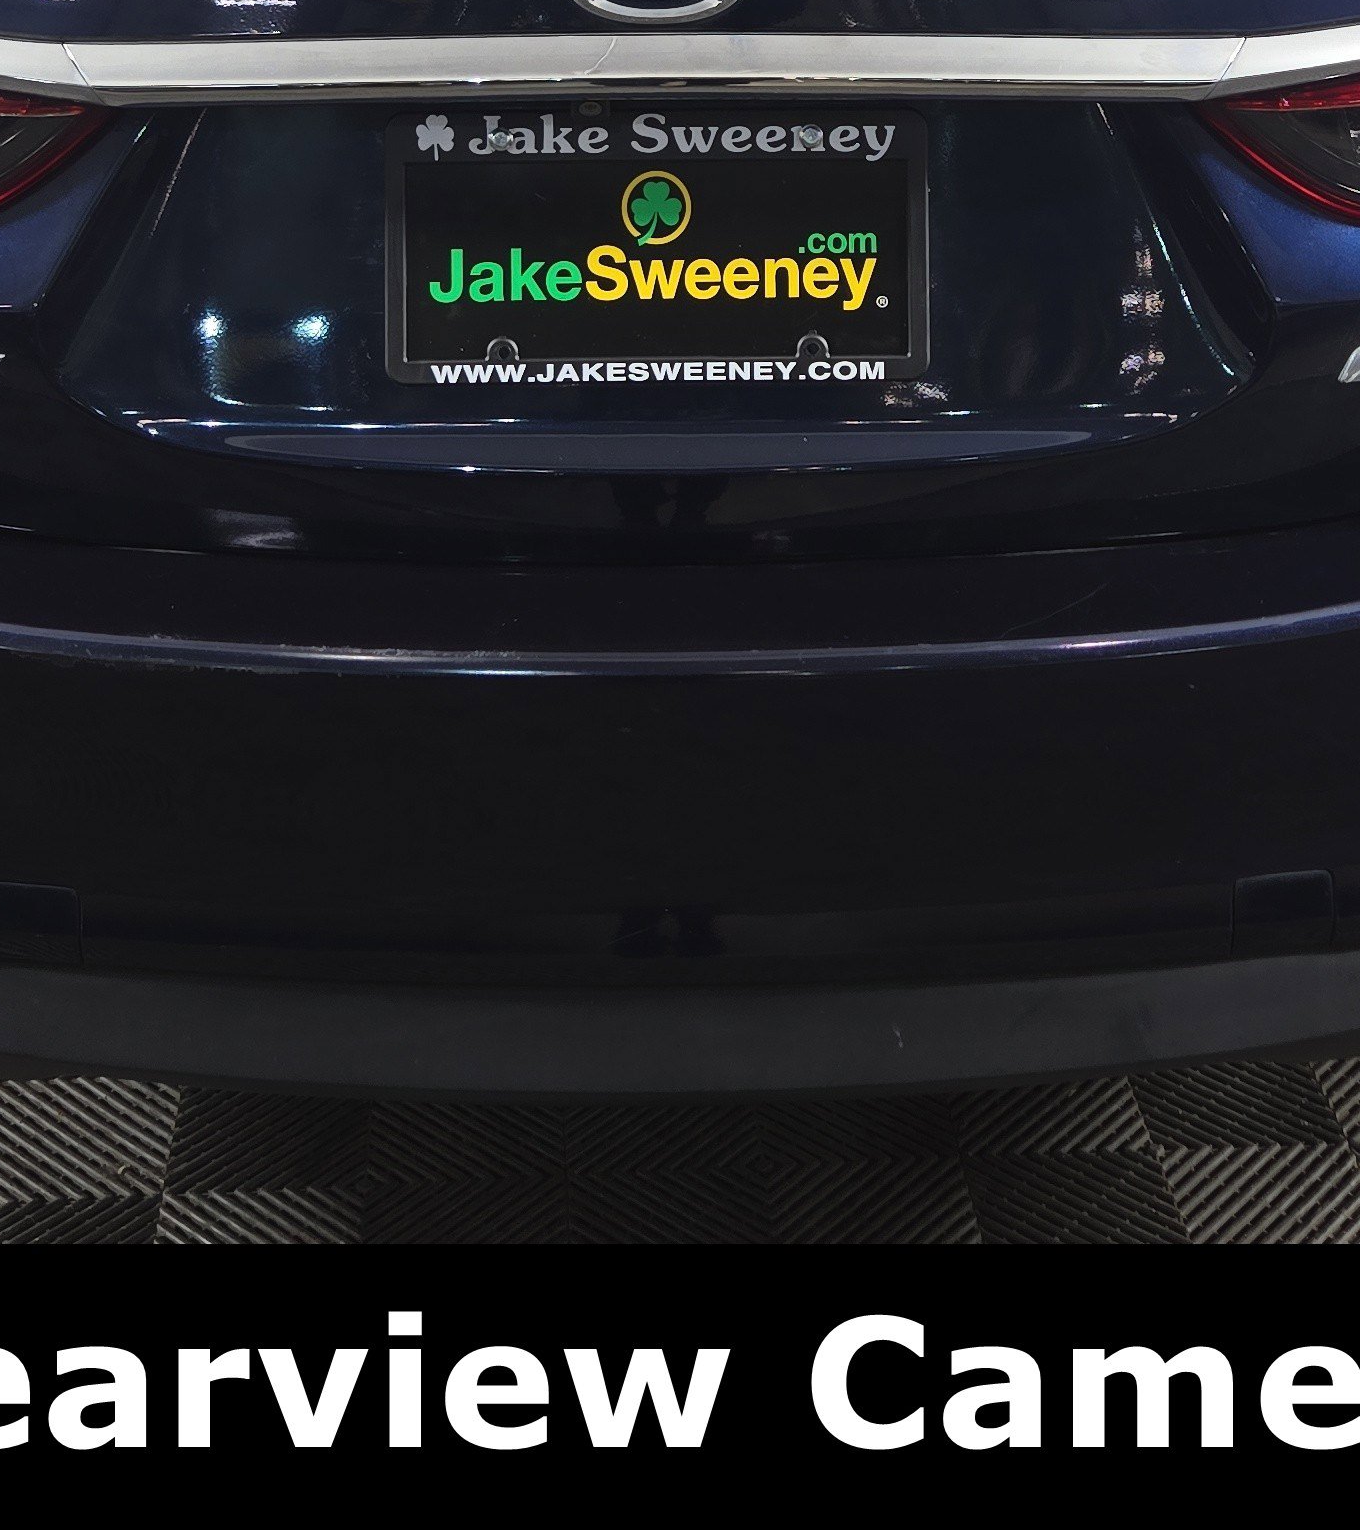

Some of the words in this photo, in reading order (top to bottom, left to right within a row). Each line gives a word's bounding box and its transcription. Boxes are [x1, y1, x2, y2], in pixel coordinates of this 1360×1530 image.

[468, 113, 610, 155] Jake
[630, 113, 896, 161] Sweeney
[431, 361, 886, 384] WWW.JAKESWEENEY.COM
